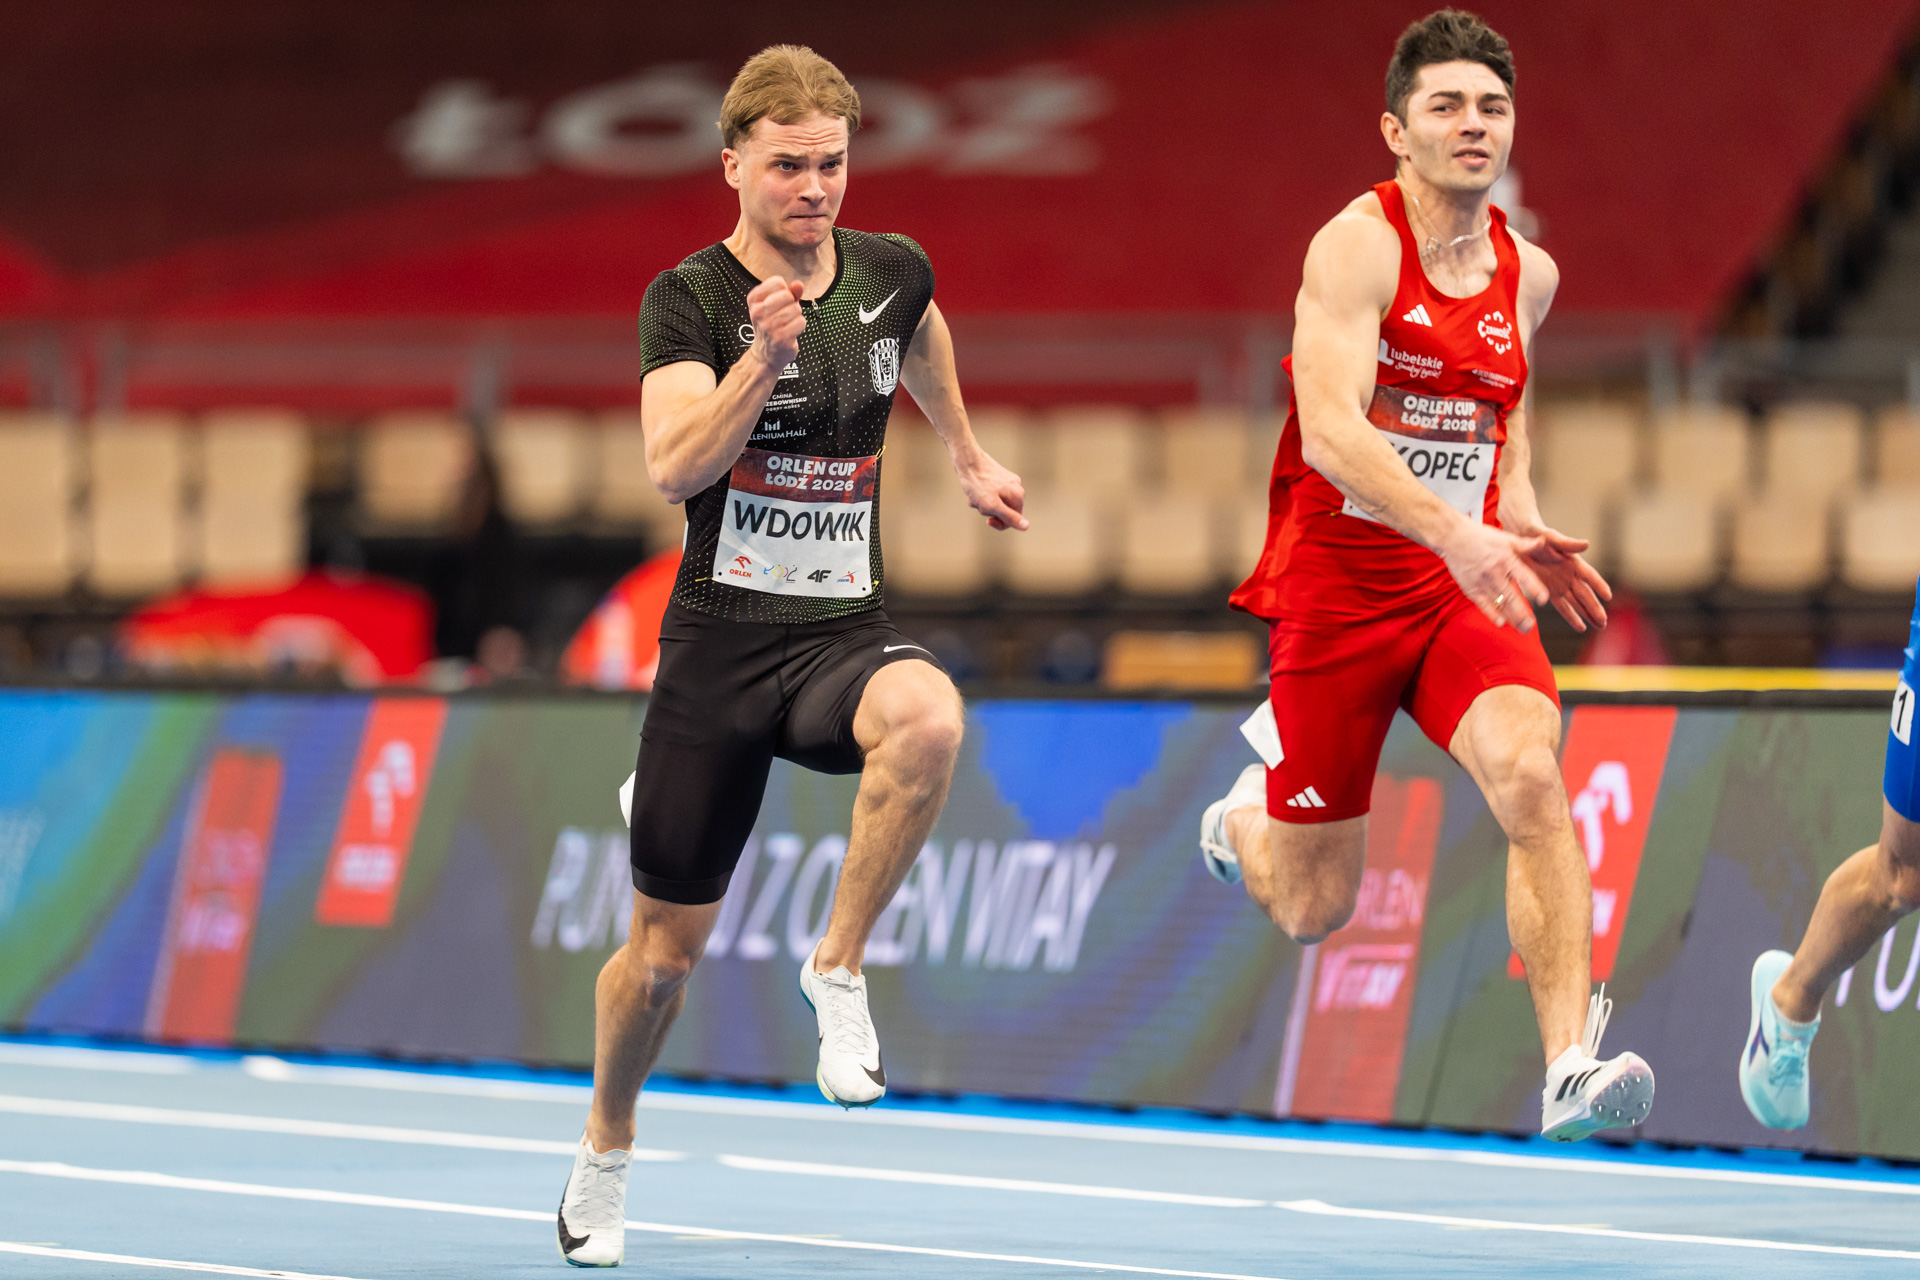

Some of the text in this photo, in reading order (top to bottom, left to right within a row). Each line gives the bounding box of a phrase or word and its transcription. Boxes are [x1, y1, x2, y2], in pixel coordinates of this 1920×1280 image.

[1391, 347, 1443, 370] lubelskie
[765, 397, 808, 407] ZEBOWNISKO
[1403, 395, 1477, 417] ORLEN CUP
[1401, 411, 1476, 432] ŁÓDŹ 2026
[767, 456, 857, 477] ORLEN CUP
[1397, 446, 1480, 482] OPEĆ
[765, 471, 854, 491] ŁÓDŹ 2026
[734, 500, 866, 541] WDOWIK
[729, 568, 752, 578] ORLEN
[807, 569, 832, 583] 4F
[1896, 690, 1908, 734] 1
